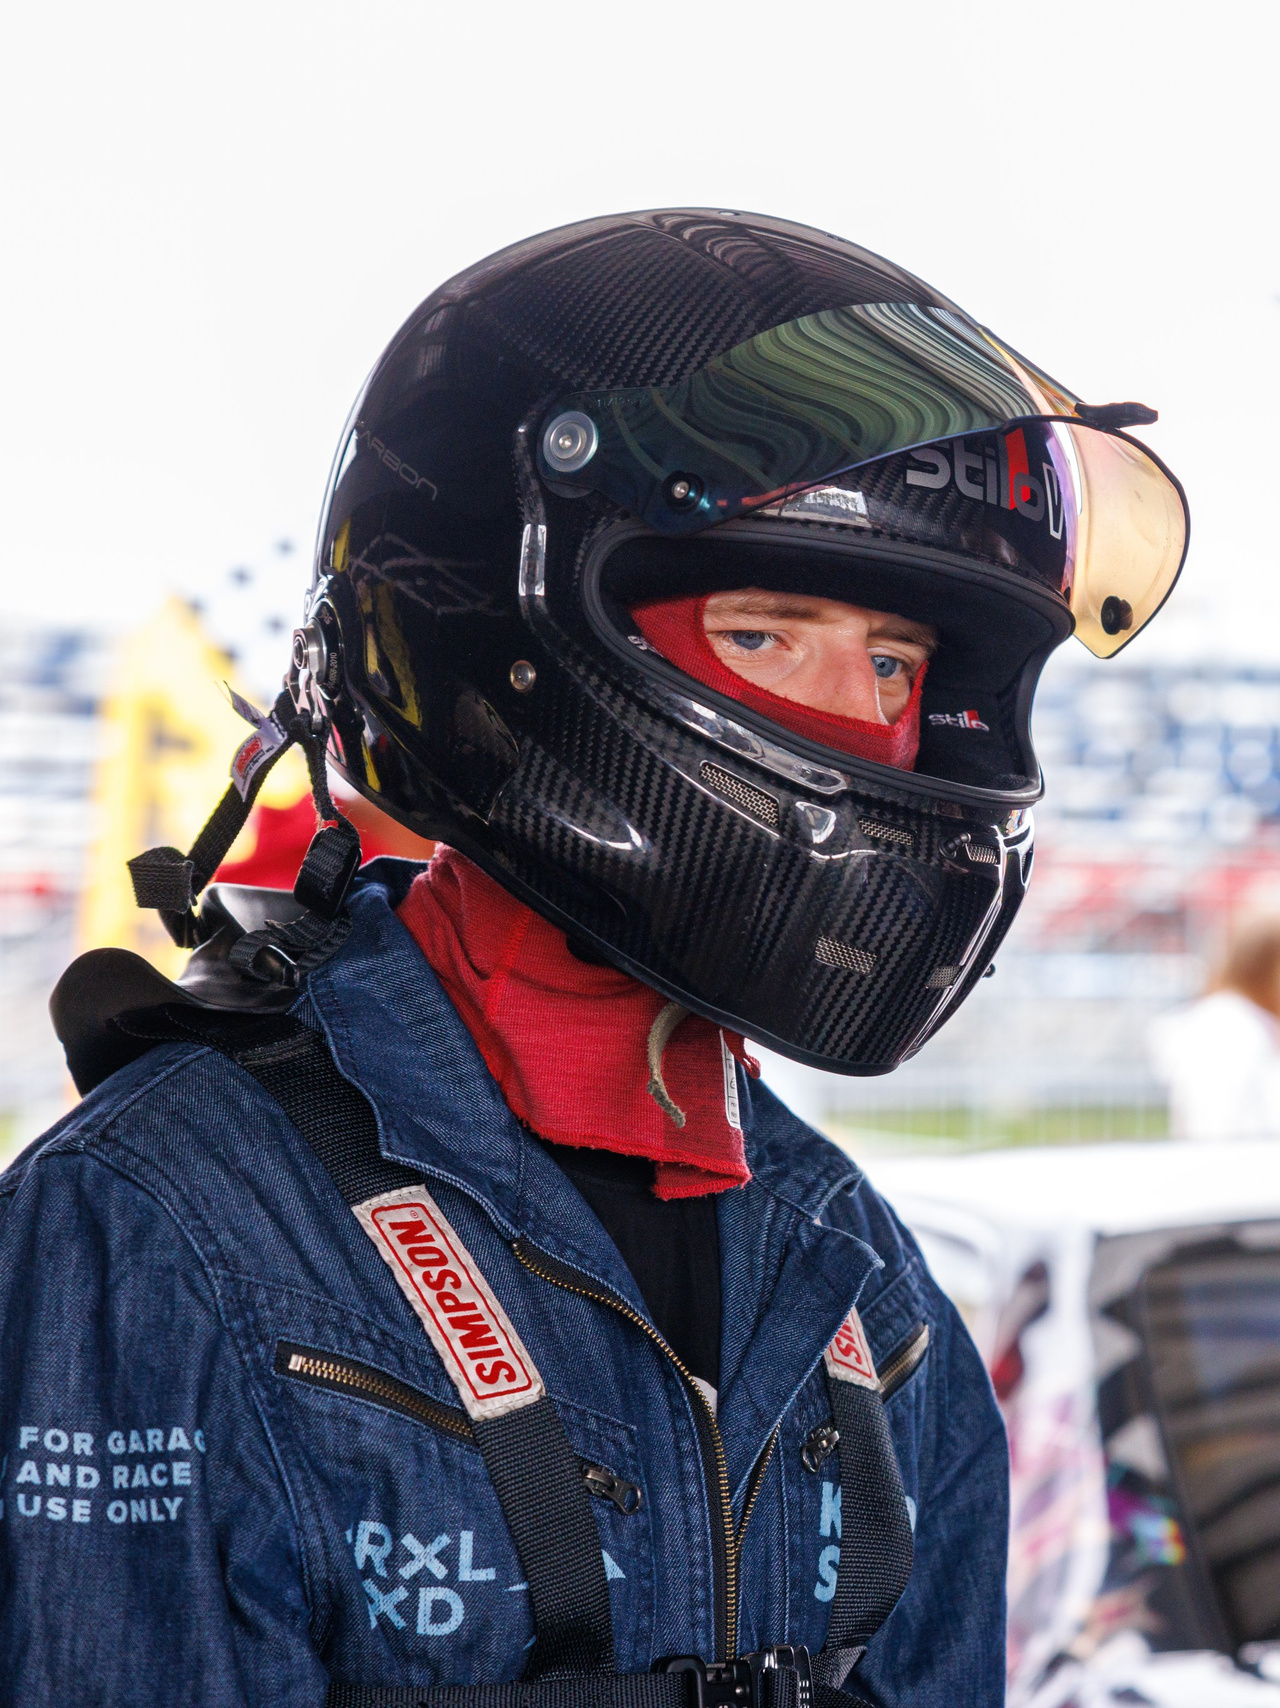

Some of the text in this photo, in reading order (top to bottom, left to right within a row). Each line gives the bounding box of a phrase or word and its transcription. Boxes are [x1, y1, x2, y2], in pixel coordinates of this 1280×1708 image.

[396, 1219, 517, 1387] SIMPSON
[20, 1426, 95, 1456] FOR
[16, 1460, 101, 1489] AND
[112, 1461, 192, 1489] RACE
[17, 1493, 184, 1524] USE ONLY
